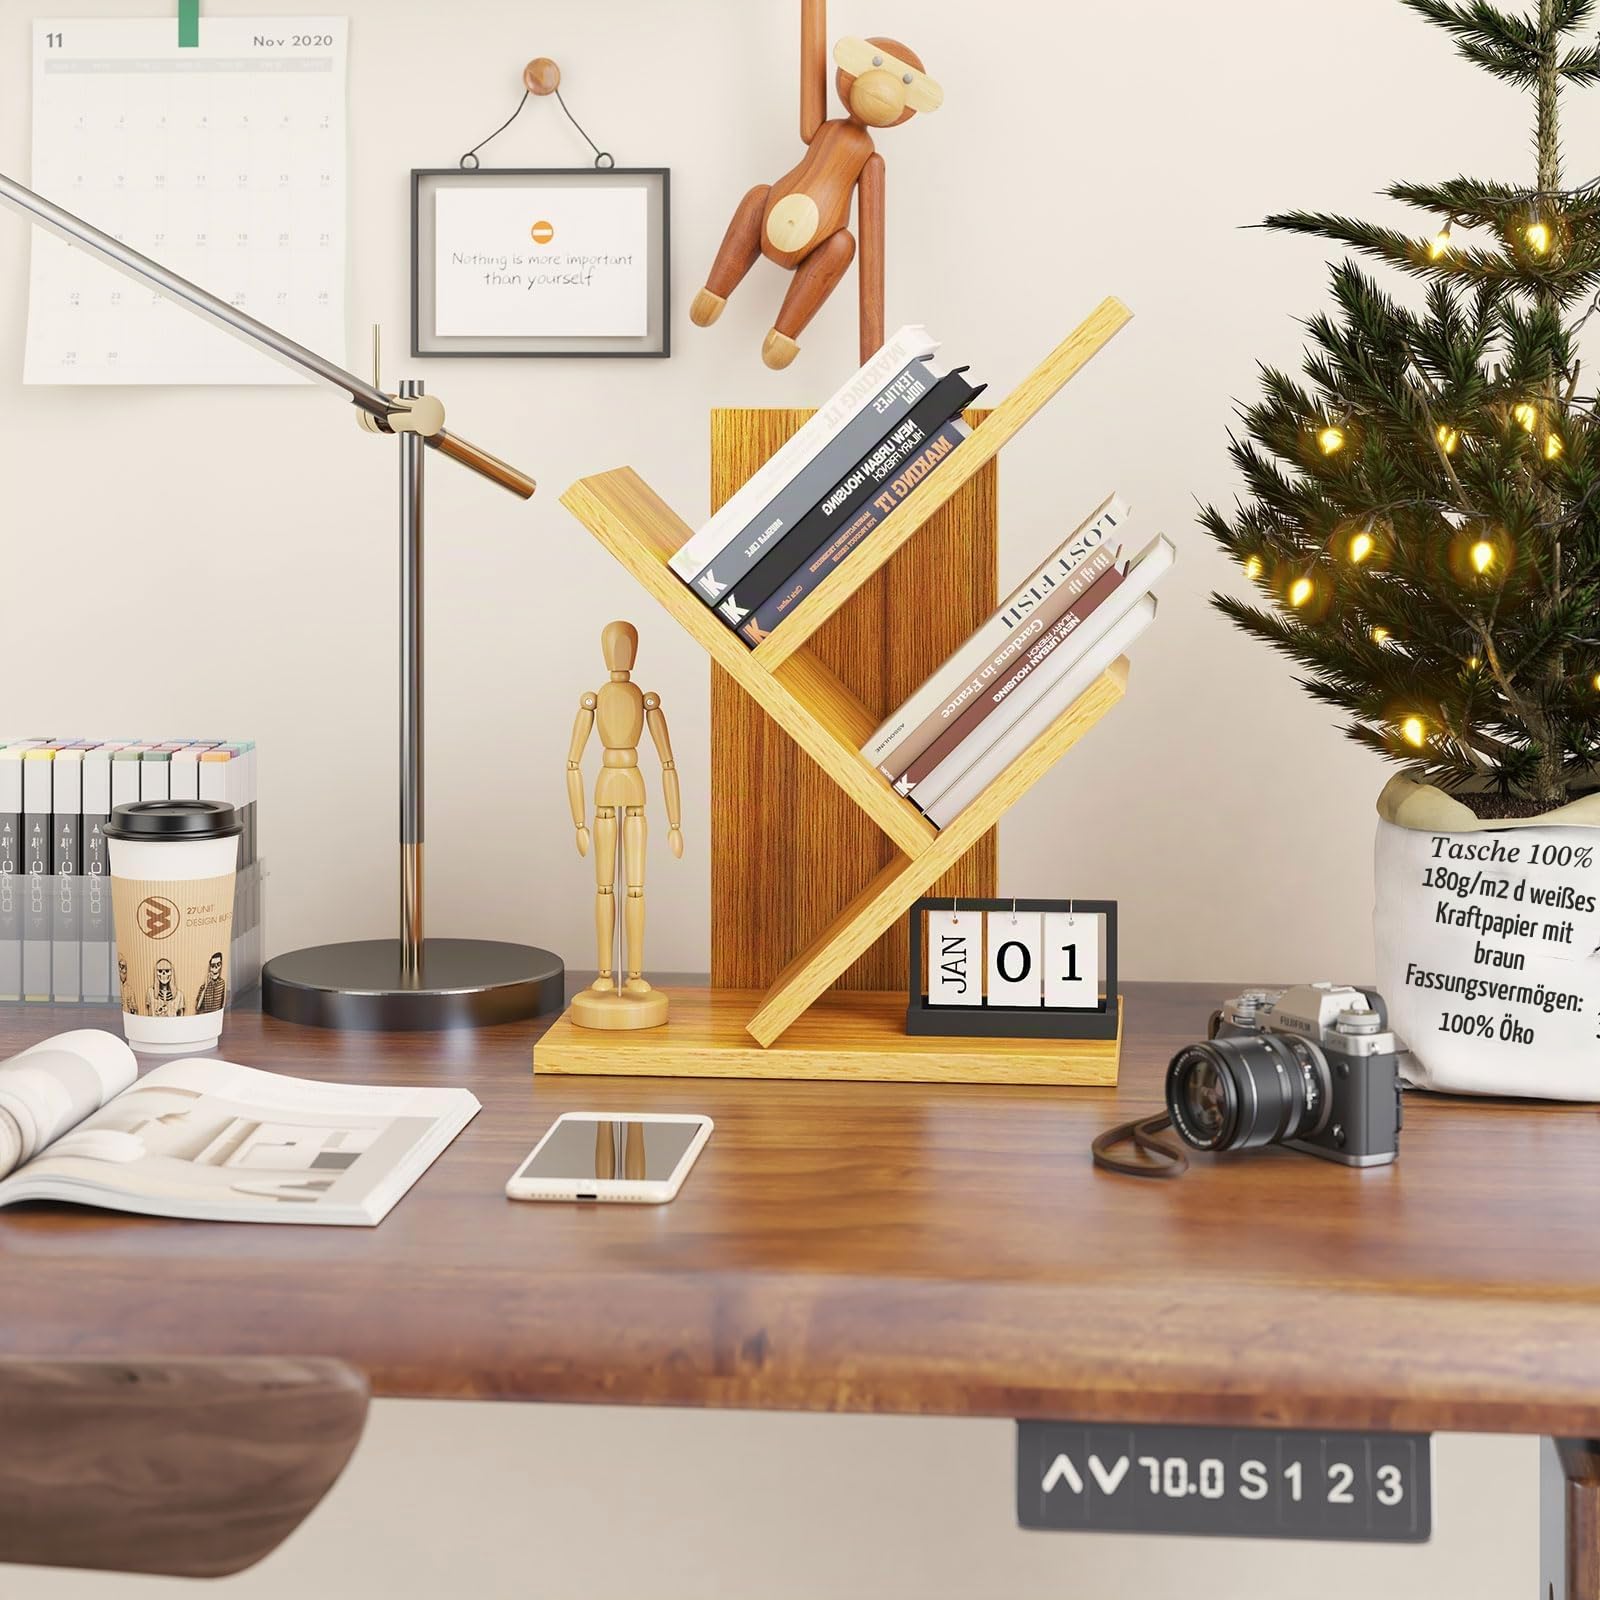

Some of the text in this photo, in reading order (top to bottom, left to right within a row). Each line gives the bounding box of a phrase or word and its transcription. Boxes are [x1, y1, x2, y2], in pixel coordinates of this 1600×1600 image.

[46, 33, 63, 48] 11
[253, 35, 333, 47] Nov 2020
[452, 252, 632, 270] Nothing is more important
[484, 267, 594, 290] than yourself
[1052, 511, 1118, 577] LOST
[999, 573, 1056, 629] FISH
[1025, 610, 1074, 659] HILARY FRENCH
[939, 616, 1045, 721] Gardens in France
[990, 615, 1081, 704] NEW URBAN HOUSING
[1431, 836, 1593, 868] Tasche 100%
[1422, 867, 1596, 913] 180g/m2 d weißes
[186, 916, 217, 927] DESIGN
[1435, 901, 1574, 944] Kraftpapier mit
[941, 936, 966, 994] JAN
[1474, 941, 1525, 970] braun
[1405, 963, 1584, 1013] Fassungsvermögen:
[1438, 1012, 1535, 1045] 100% Öko
[1239, 1460, 1269, 1500] S
[1283, 1462, 1301, 1501] 1
[1327, 1463, 1354, 1504] 2
[1376, 1465, 1403, 1505] 3
